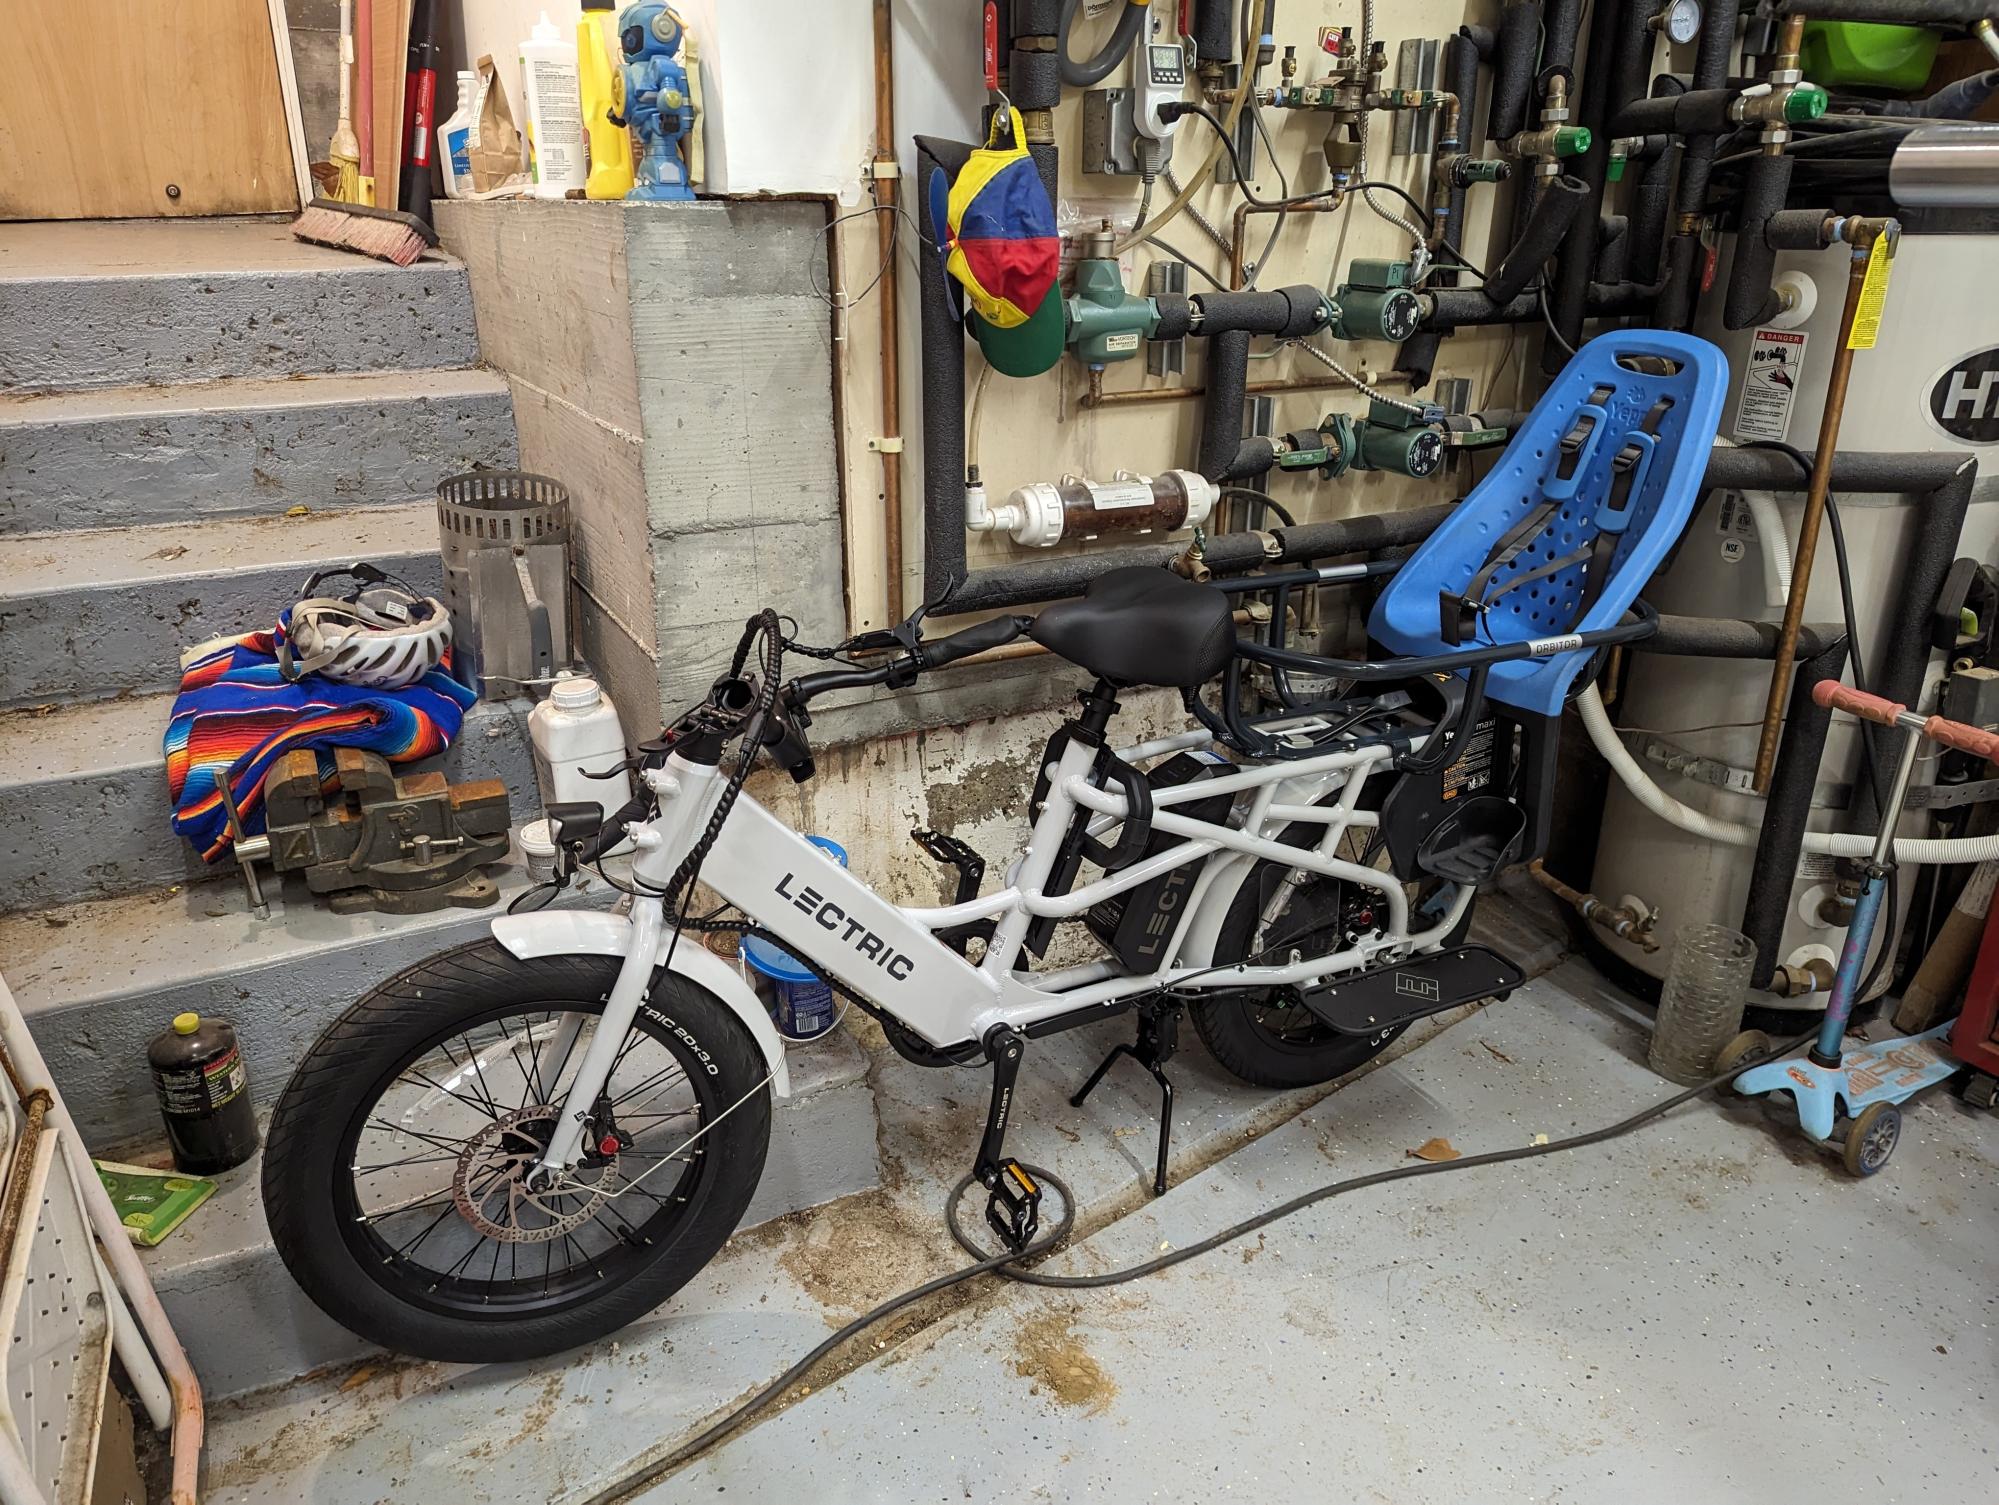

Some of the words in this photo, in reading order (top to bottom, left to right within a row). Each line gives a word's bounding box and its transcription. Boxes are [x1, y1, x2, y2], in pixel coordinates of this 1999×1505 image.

[1767, 333, 1800, 343] DANGER
[1725, 543, 1739, 553] NSF
[1536, 639, 1577, 654] ORBITOR
[1475, 717, 1496, 731] maxi
[1138, 863, 1192, 955] LECT
[774, 872, 915, 981] LECTRIC
[674, 1027, 719, 1075] 20x3.0
[996, 1087, 1010, 1129] LECTRIC
